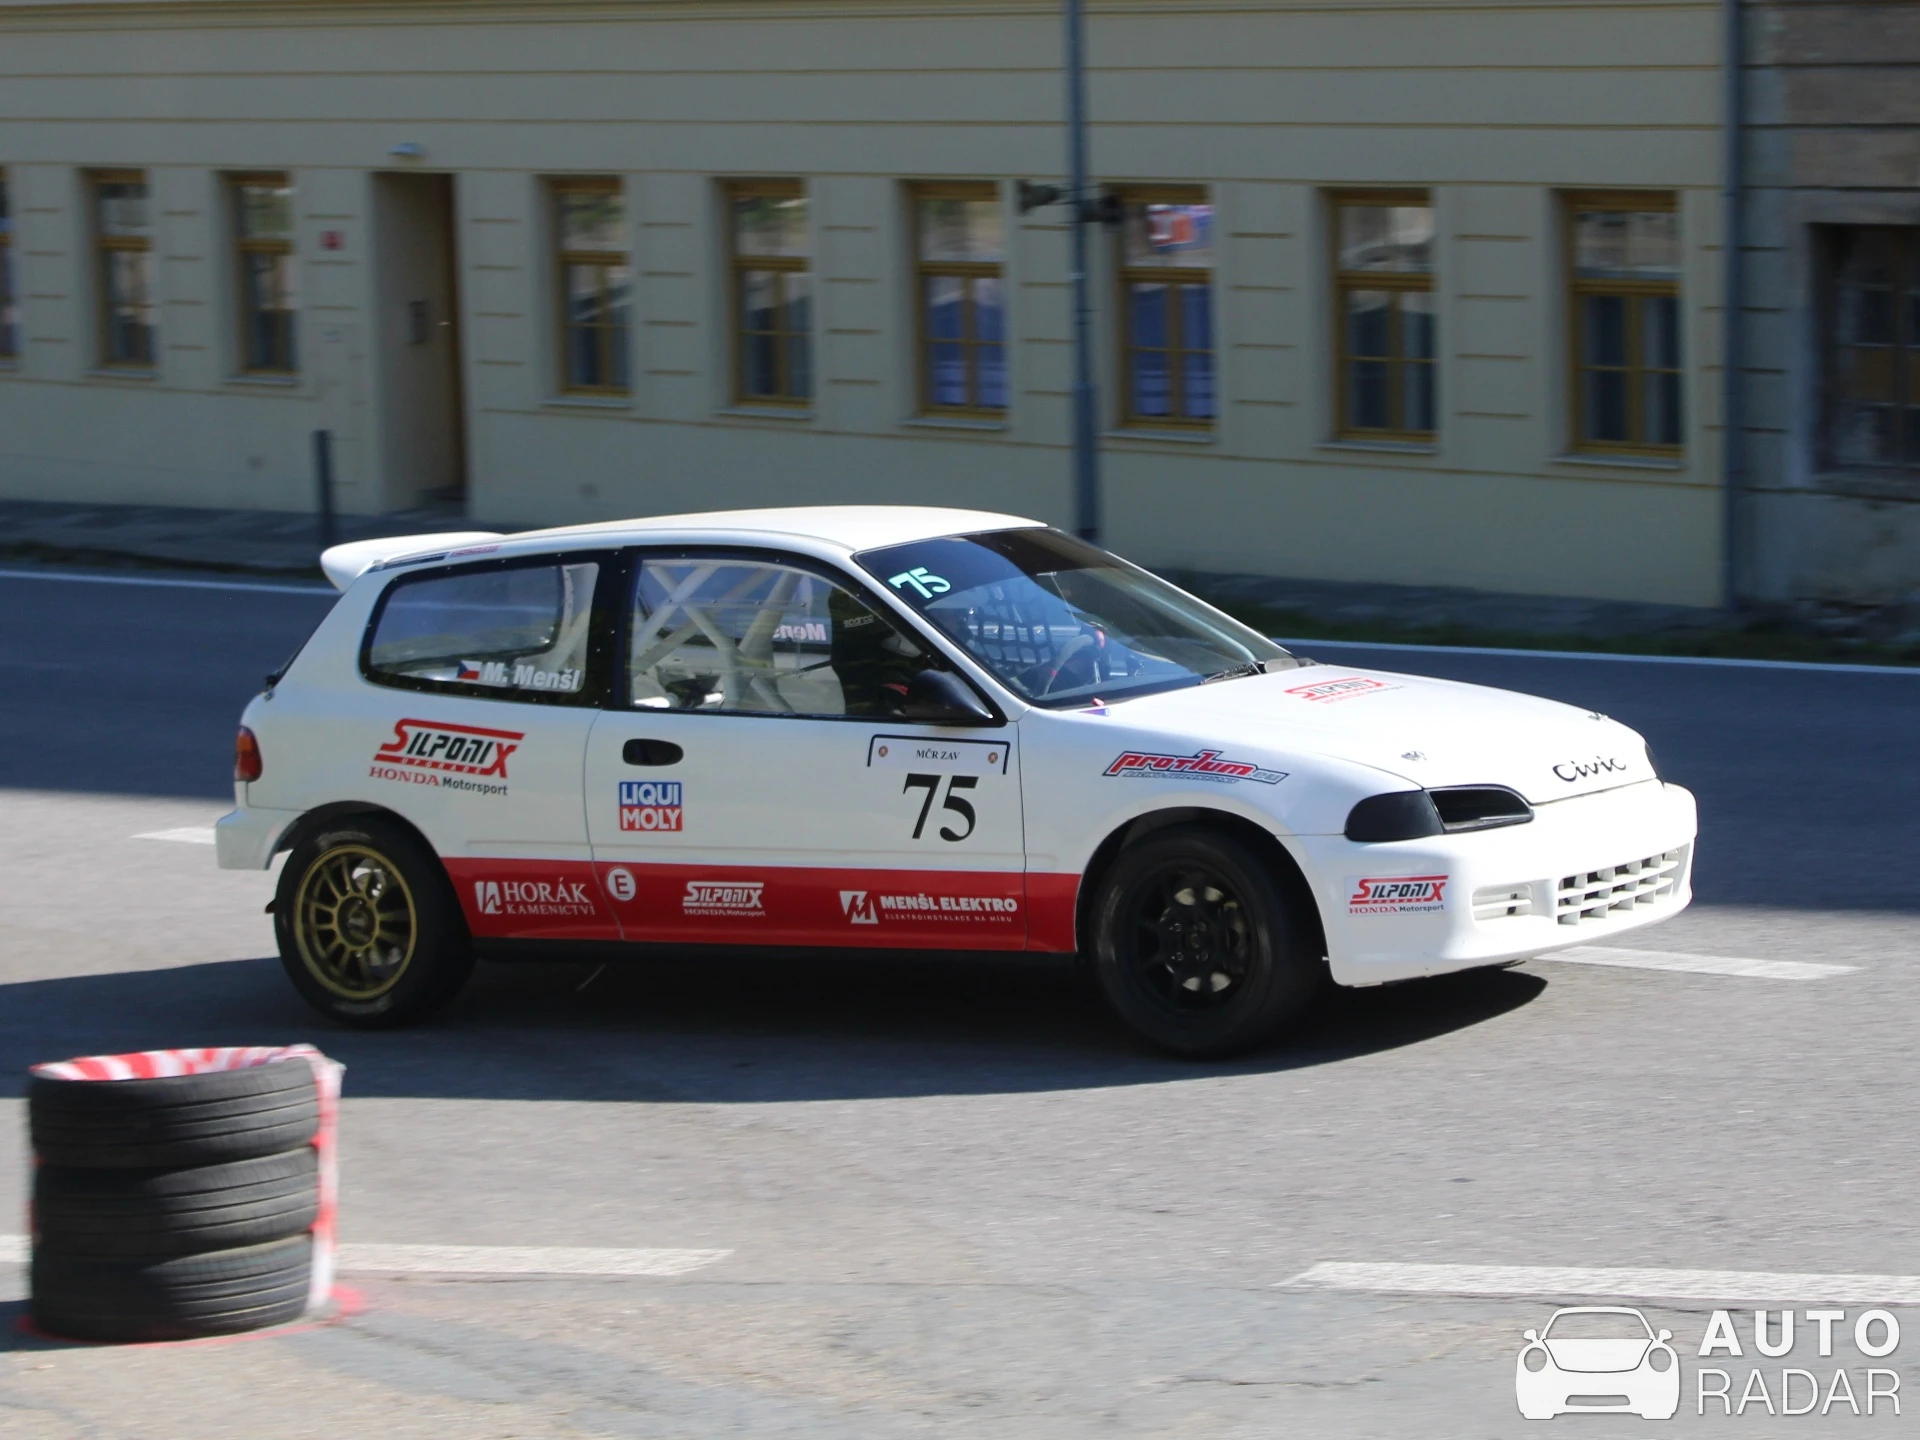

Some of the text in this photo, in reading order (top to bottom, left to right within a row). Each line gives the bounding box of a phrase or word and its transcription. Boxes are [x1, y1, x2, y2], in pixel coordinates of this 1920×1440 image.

[888, 566, 951, 599] 75
[484, 661, 580, 690] M. Menšl
[374, 718, 525, 778] SILPONIX
[916, 748, 960, 760] MČR ZAV
[368, 766, 508, 796] HONDA Motorsport
[1552, 756, 1626, 782] Civic
[622, 783, 679, 806] LIQUI
[903, 773, 979, 842] 75
[622, 808, 681, 830] MOLY
[502, 877, 591, 903] HORÁK
[614, 874, 630, 895] E
[683, 882, 764, 908] SILPONIX
[1350, 875, 1449, 905] SILPONIX
[506, 902, 596, 915] KAMENICTVÍ
[880, 893, 1018, 912] MENŠL ELEKTRO
[1348, 904, 1444, 914] HONDA Motorsport
